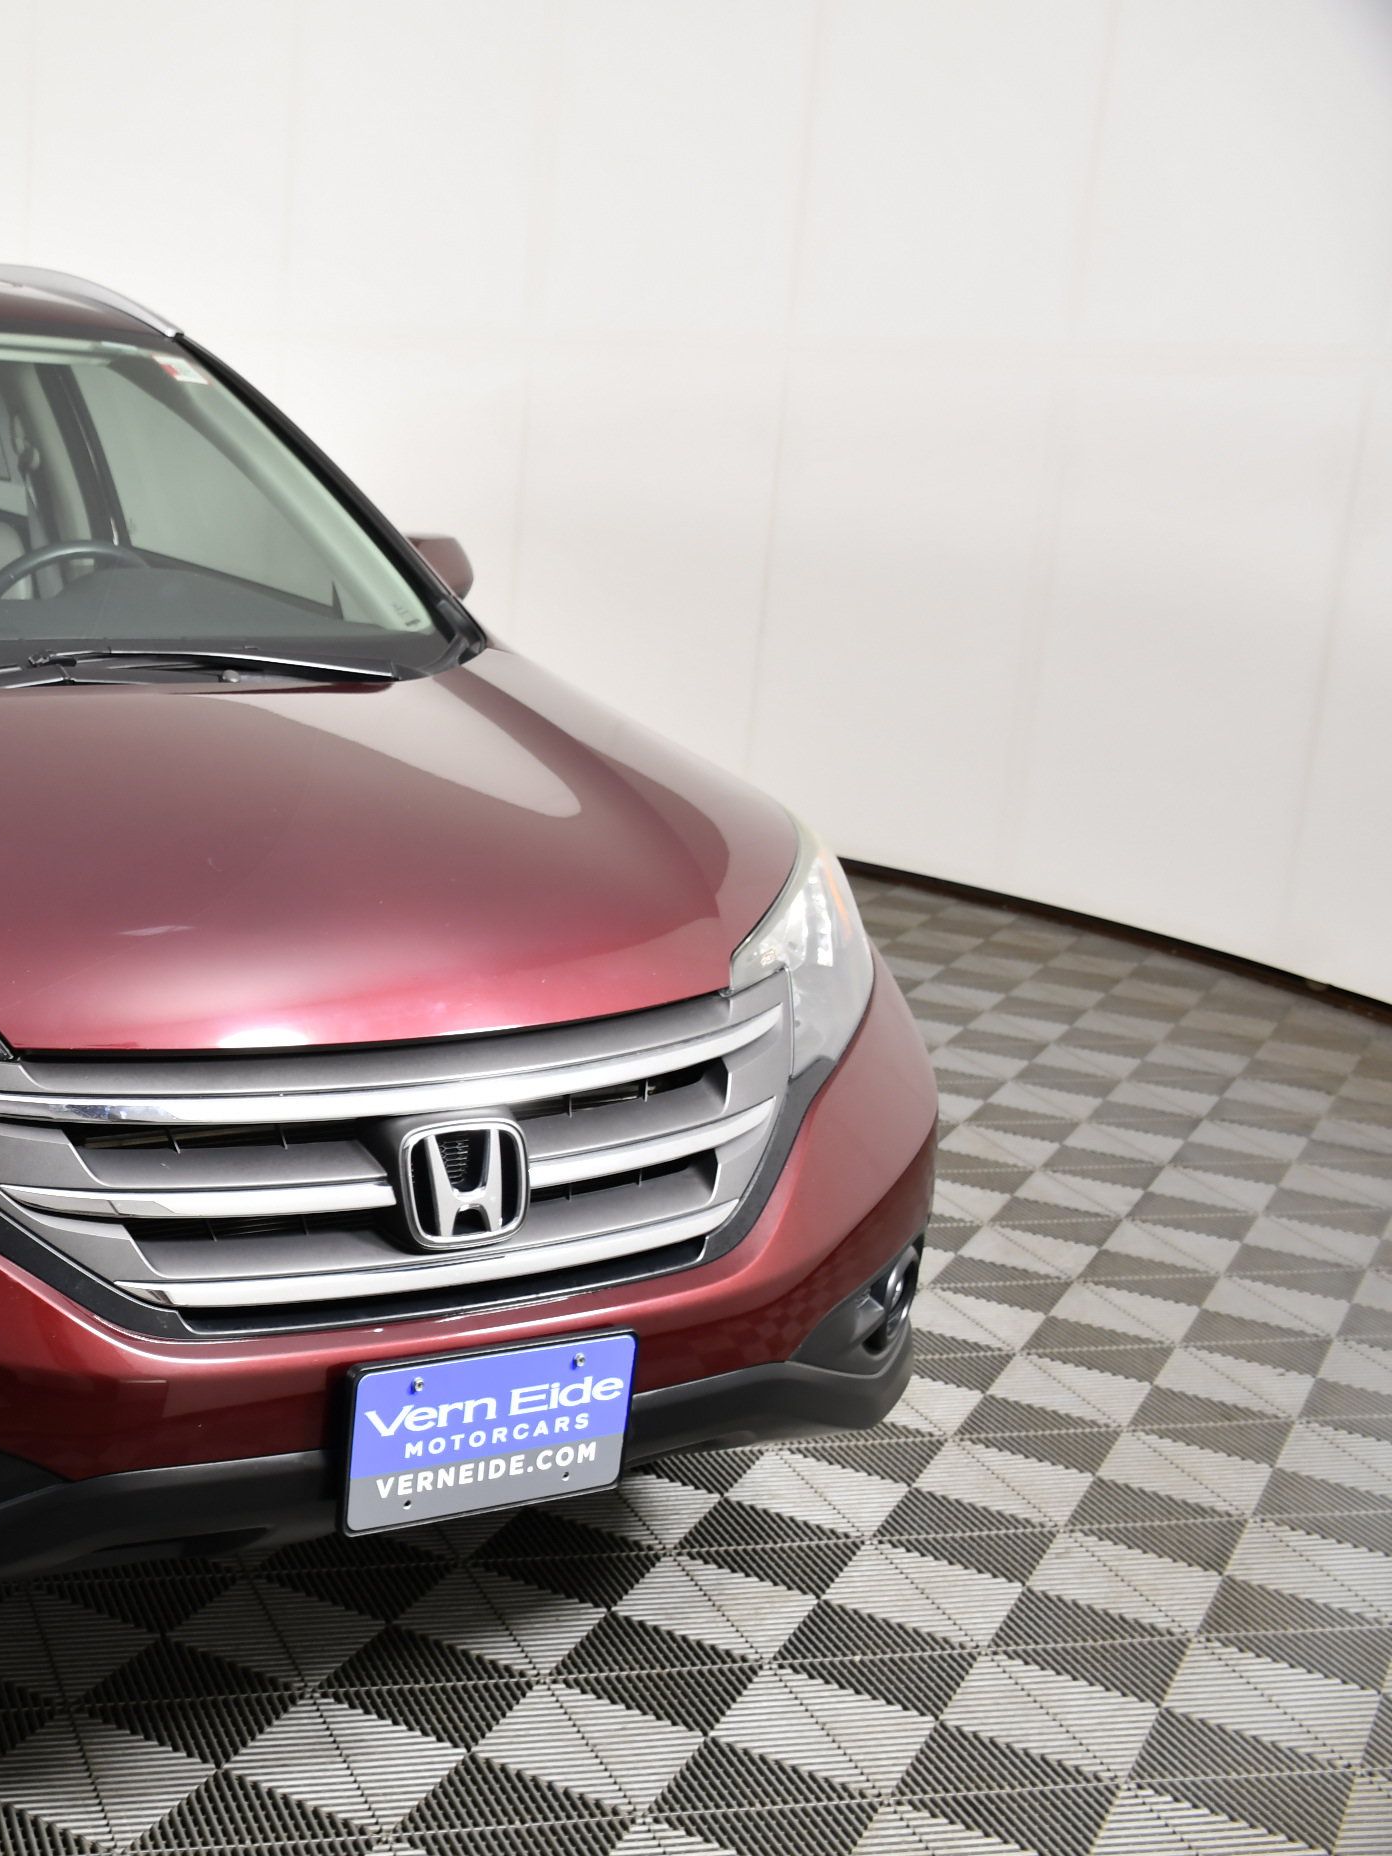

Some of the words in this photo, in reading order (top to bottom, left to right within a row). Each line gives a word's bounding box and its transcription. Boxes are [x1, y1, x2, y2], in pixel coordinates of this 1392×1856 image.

[364, 1396, 497, 1438] Vern
[509, 1375, 624, 1416] Eide
[404, 1412, 590, 1459] MOTORCARS
[376, 1441, 597, 1499] VERNEIDE.COM
